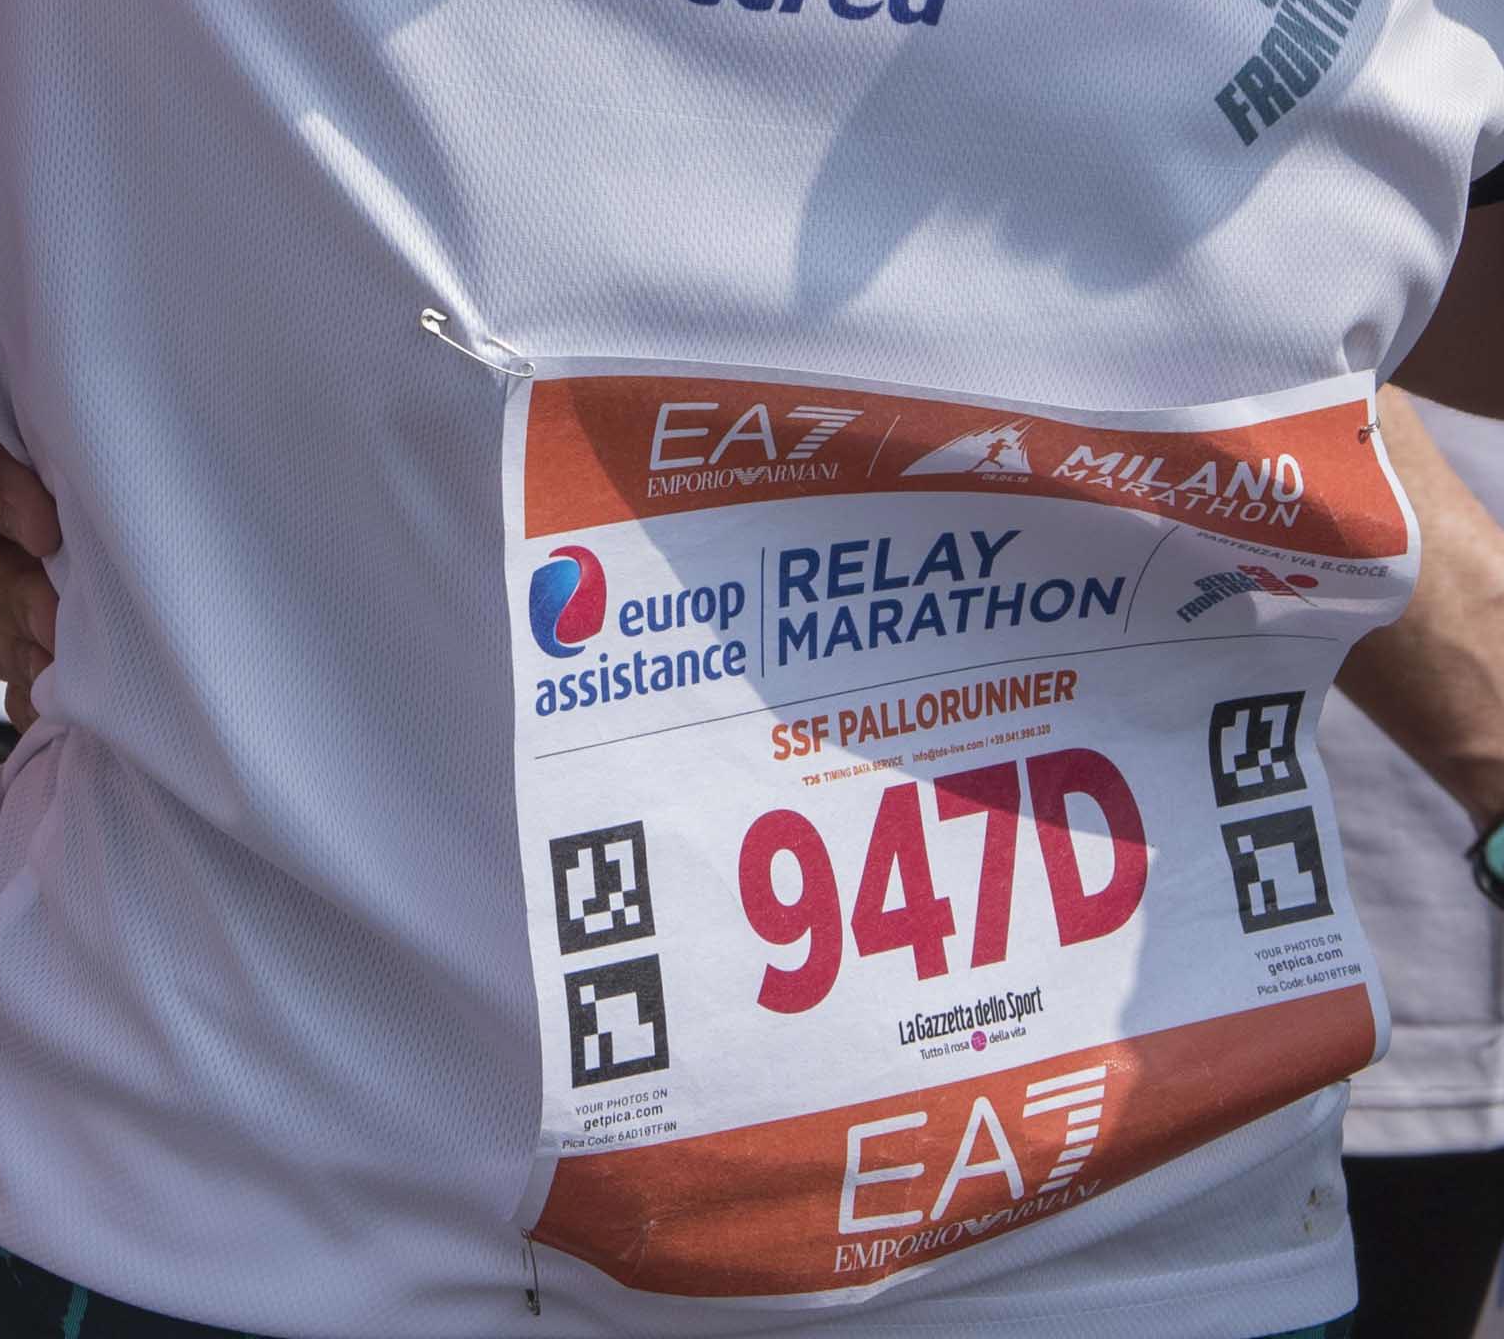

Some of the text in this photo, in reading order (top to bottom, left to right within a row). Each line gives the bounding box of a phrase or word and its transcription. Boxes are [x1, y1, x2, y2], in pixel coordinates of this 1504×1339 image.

[649, 401, 864, 471] EA7
[647, 462, 839, 499] EMPORIO ARMANI
[1051, 464, 1301, 528] MARATHON
[1066, 444, 1304, 503] MILANO
[778, 529, 1023, 609] RELAY
[1290, 555, 1316, 568] VIA
[619, 581, 746, 637] europ
[778, 576, 1126, 667] MARATHON
[534, 640, 746, 717] assistance
[772, 669, 1078, 761] SSF PALLORUNNER
[737, 747, 1152, 1016] 947D
[1254, 933, 1342, 961] YOUR PHOTOS ON
[1268, 948, 1343, 976] getpica.com
[975, 995, 1007, 1026] dello
[1006, 986, 1043, 1022] Sport
[1257, 985, 1278, 995] Pica
[920, 1046, 943, 1060] Tutto
[951, 1040, 970, 1053] rosa
[989, 1030, 1009, 1044] della
[1011, 1025, 1026, 1039] vita
[575, 1089, 667, 1116] YOUR PHOTOS ON
[584, 1104, 663, 1132] getpica.com
[562, 1138, 584, 1149] Pica
[837, 1064, 1108, 1237] EA7
[832, 1177, 1103, 1275] EMPORIO ARMANI
